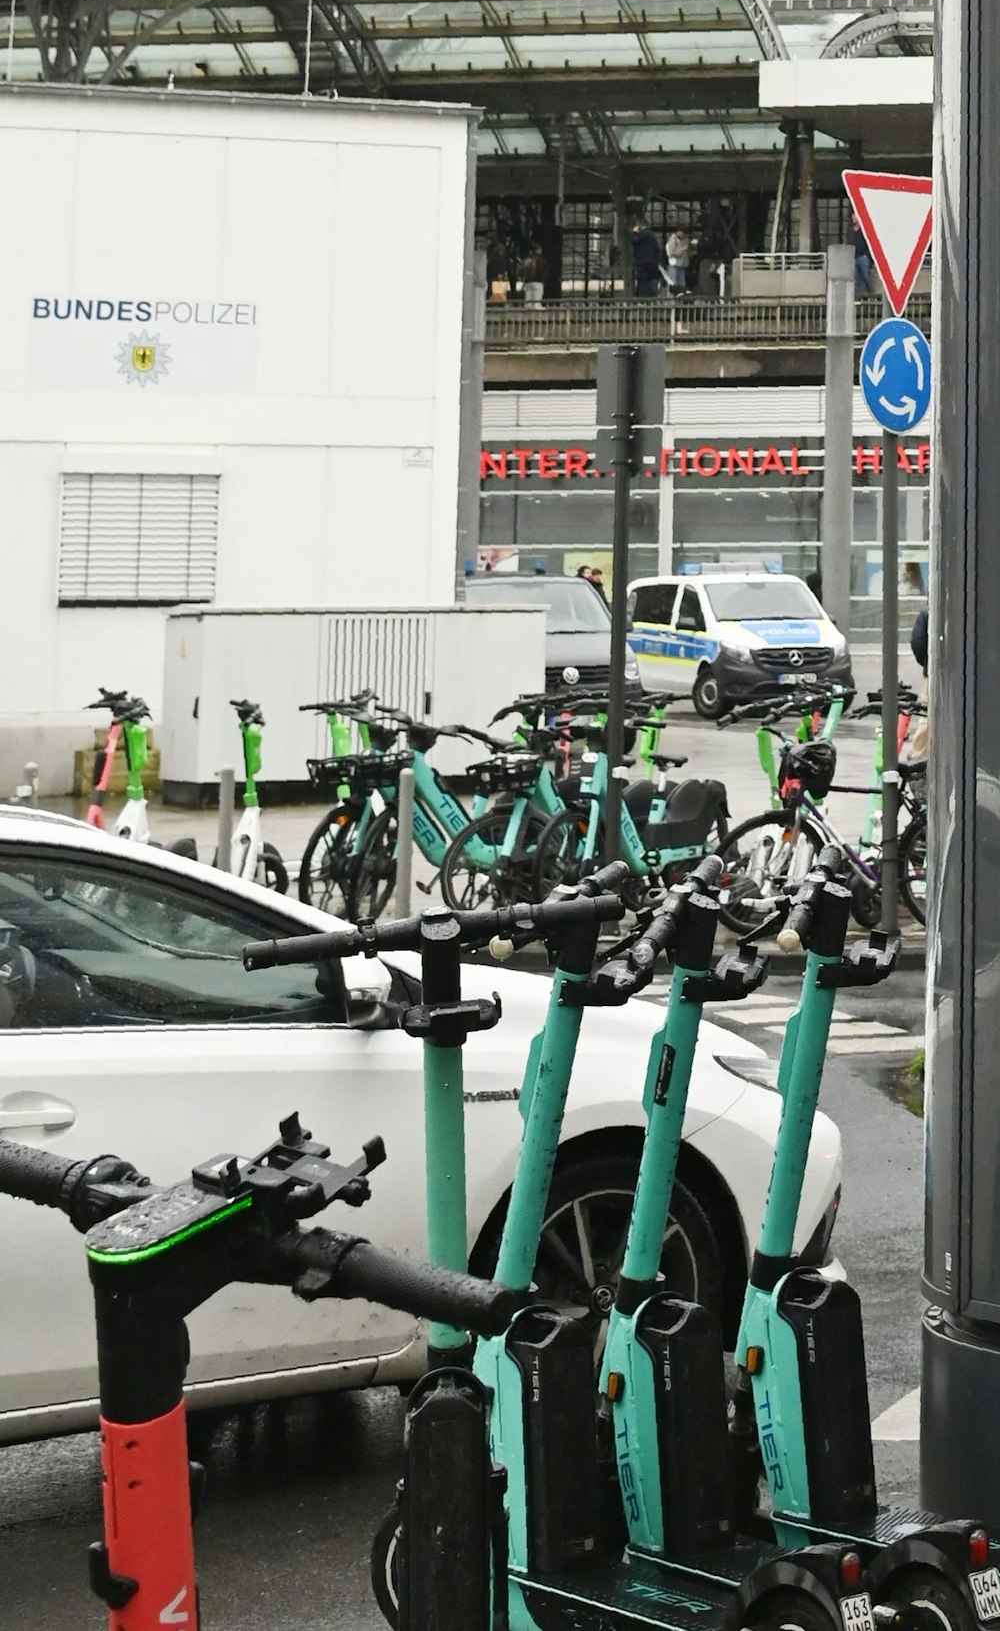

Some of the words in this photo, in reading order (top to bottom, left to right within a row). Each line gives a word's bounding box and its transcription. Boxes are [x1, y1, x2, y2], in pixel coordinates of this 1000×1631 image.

[32, 298, 257, 326] BUNDESPOLIZEI
[806, 1318, 816, 1364] TIER
[532, 1355, 540, 1402] TIER
[663, 1344, 672, 1392] TIER
[759, 1390, 785, 1495] TIER
[617, 1417, 640, 1527] TIER
[625, 1582, 713, 1614] TIER
[844, 1598, 869, 1621] 163
